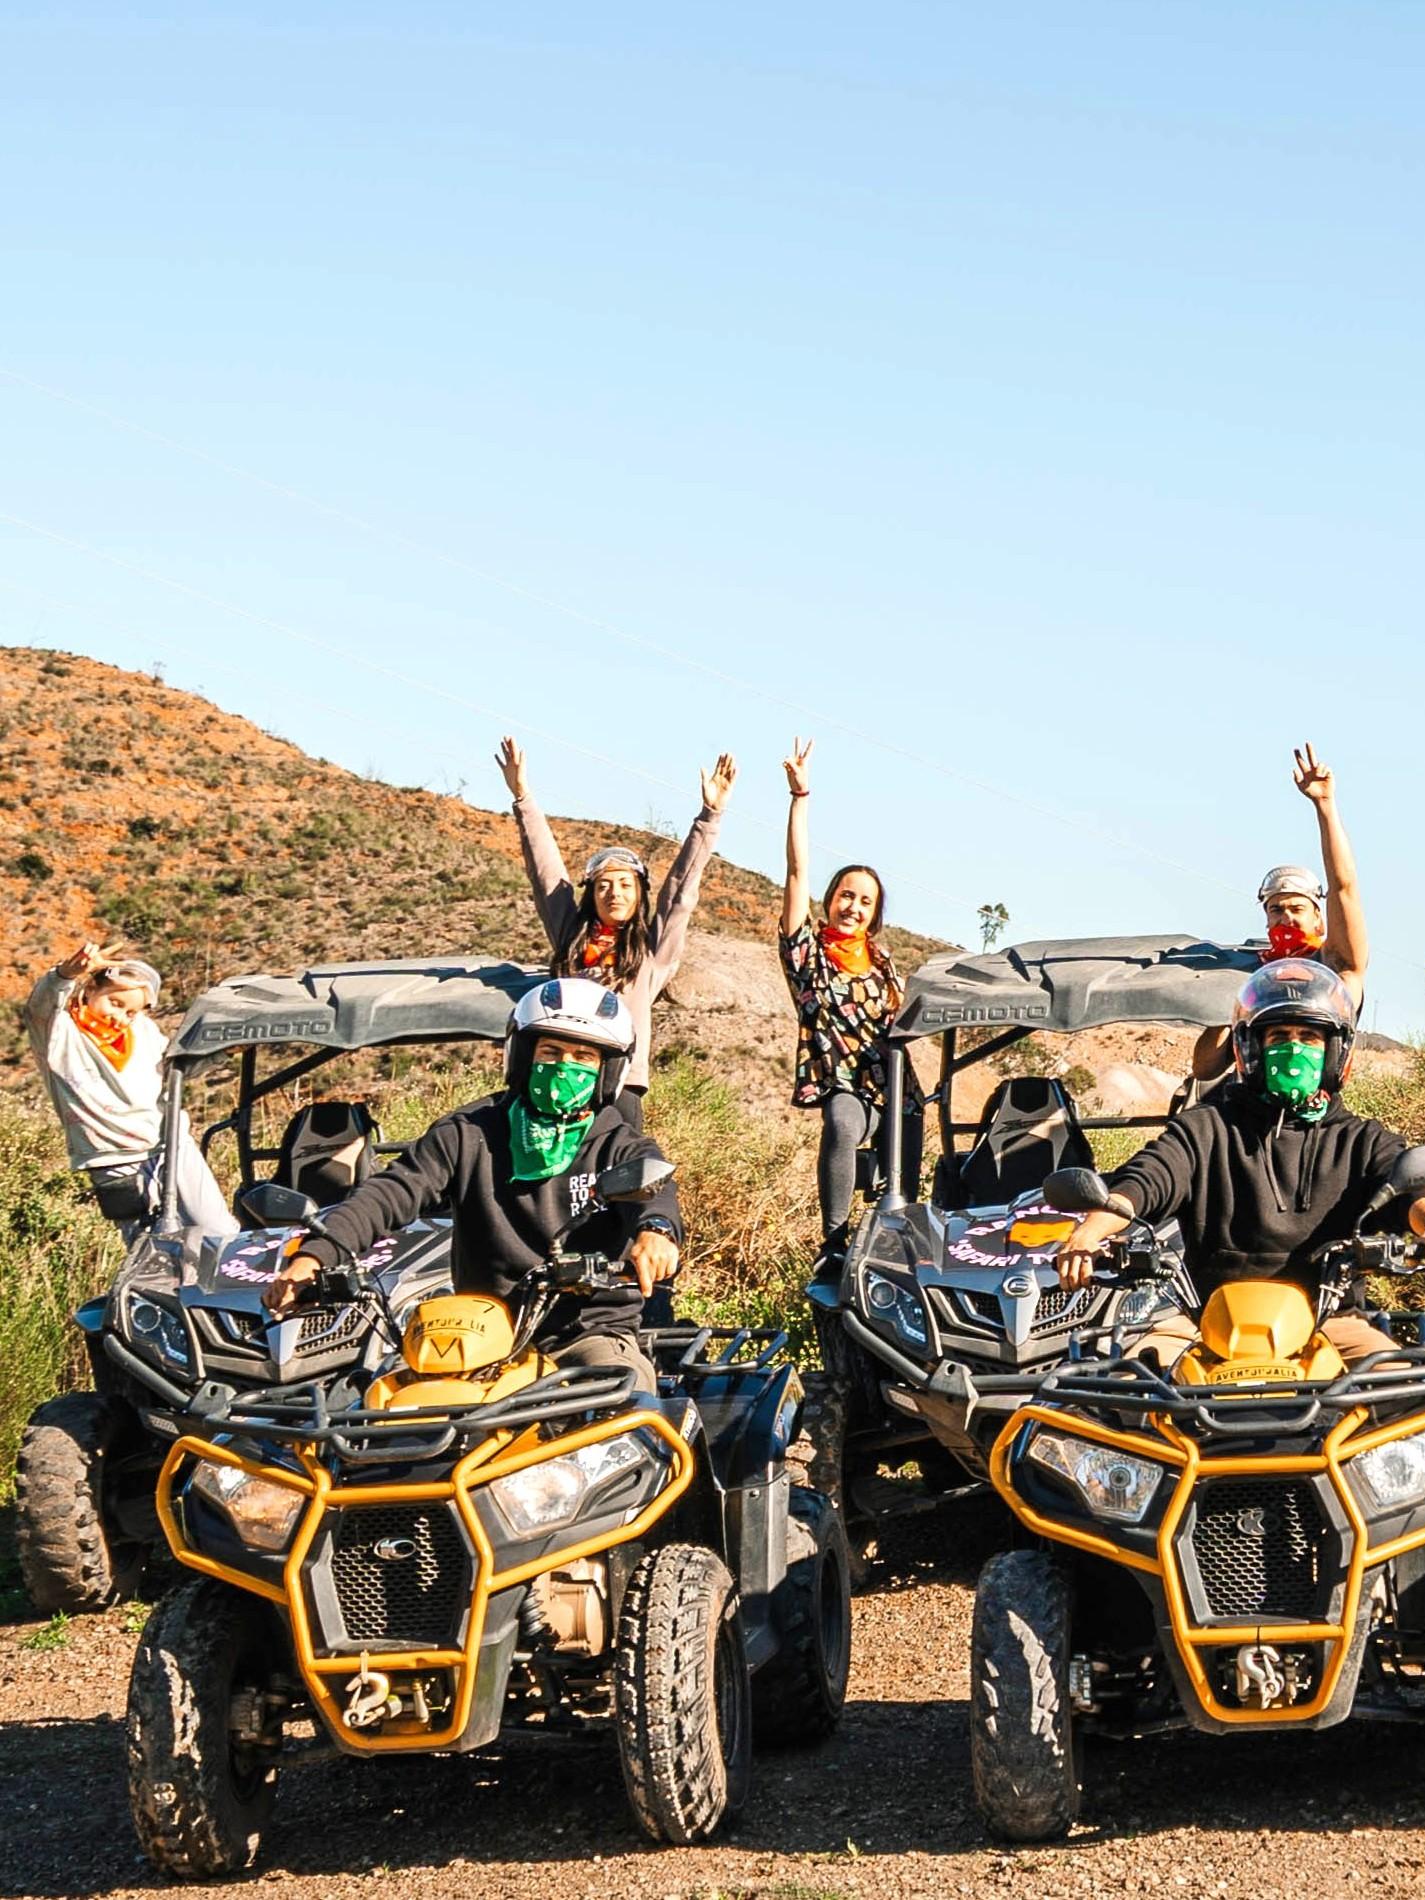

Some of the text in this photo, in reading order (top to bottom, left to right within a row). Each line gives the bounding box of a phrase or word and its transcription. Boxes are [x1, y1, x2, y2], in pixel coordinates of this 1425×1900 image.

[921, 1004, 1050, 1023] CFMOTO
[201, 1019, 334, 1041] CFMOTO
[569, 1167, 608, 1189] REA
